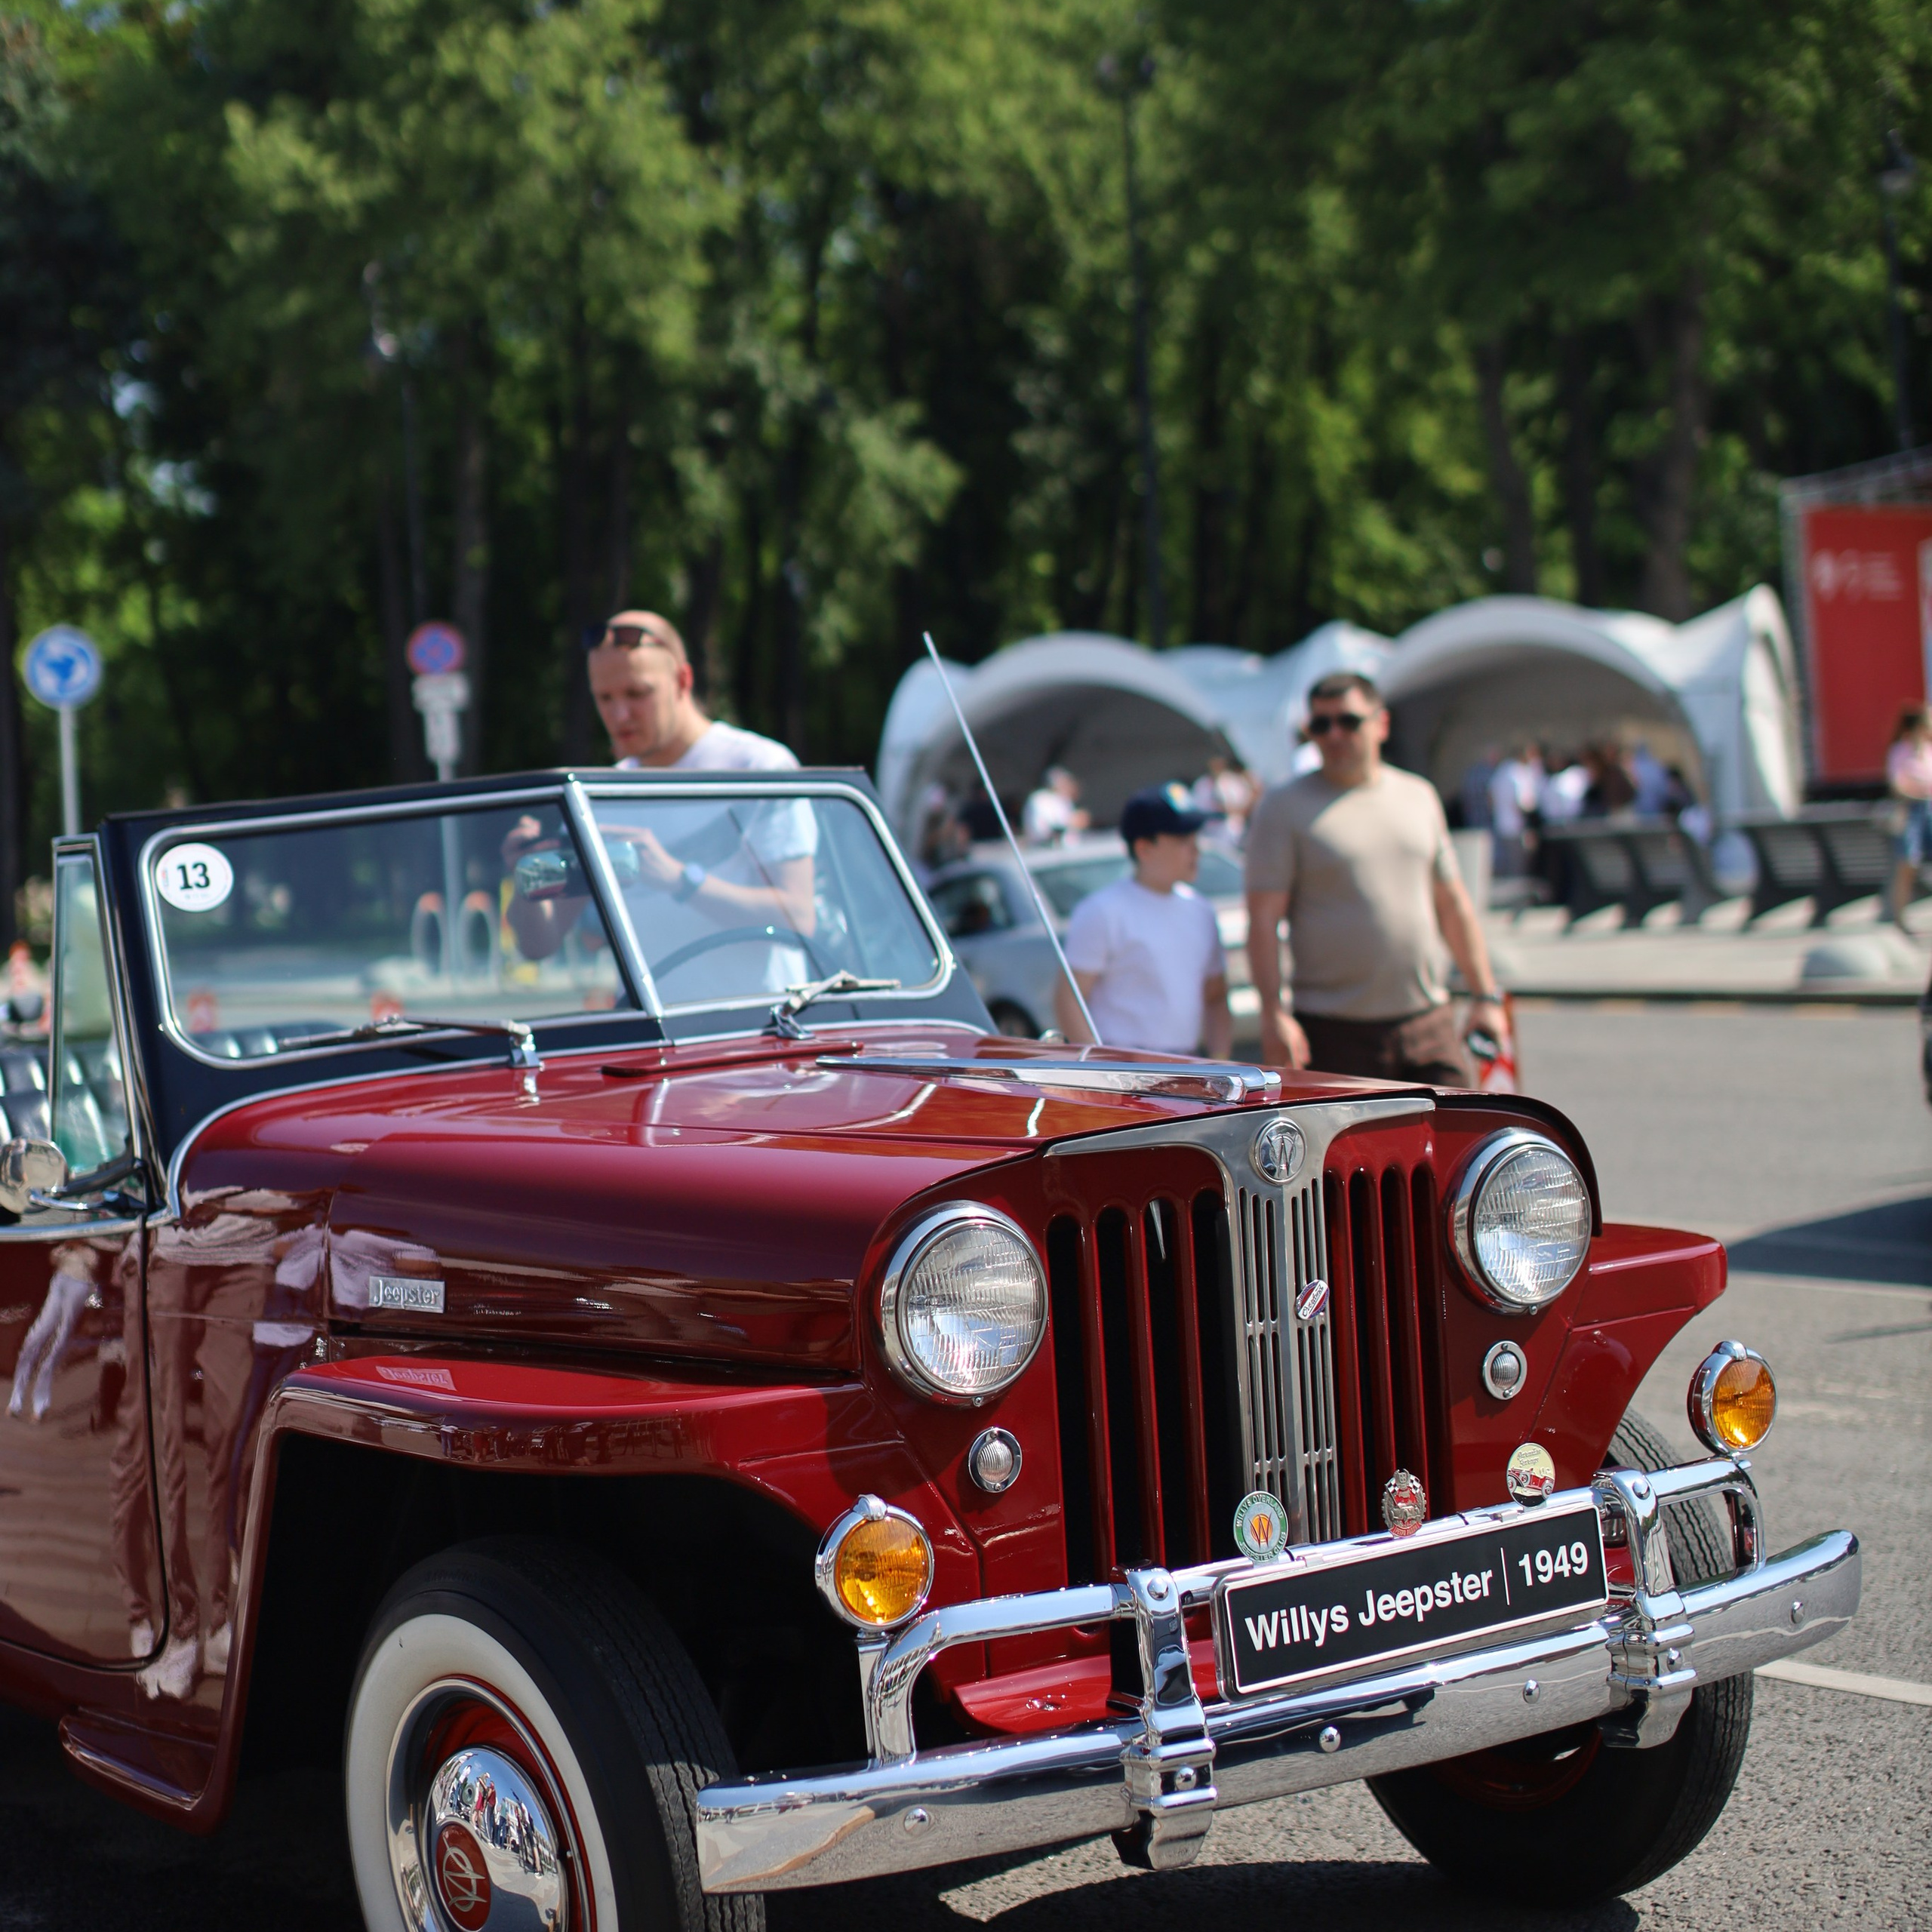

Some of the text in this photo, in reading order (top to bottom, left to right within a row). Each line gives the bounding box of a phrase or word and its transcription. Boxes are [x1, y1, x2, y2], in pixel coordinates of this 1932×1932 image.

[177, 862, 211, 891] 13
[374, 1279, 440, 1309] Jeepster
[1236, 1494, 1284, 1527] WILLYS OVERLAND
[1238, 1531, 1286, 1561] JEEPSTER CLUB
[1244, 1542, 1589, 1651] Willys Jeepster 1949
